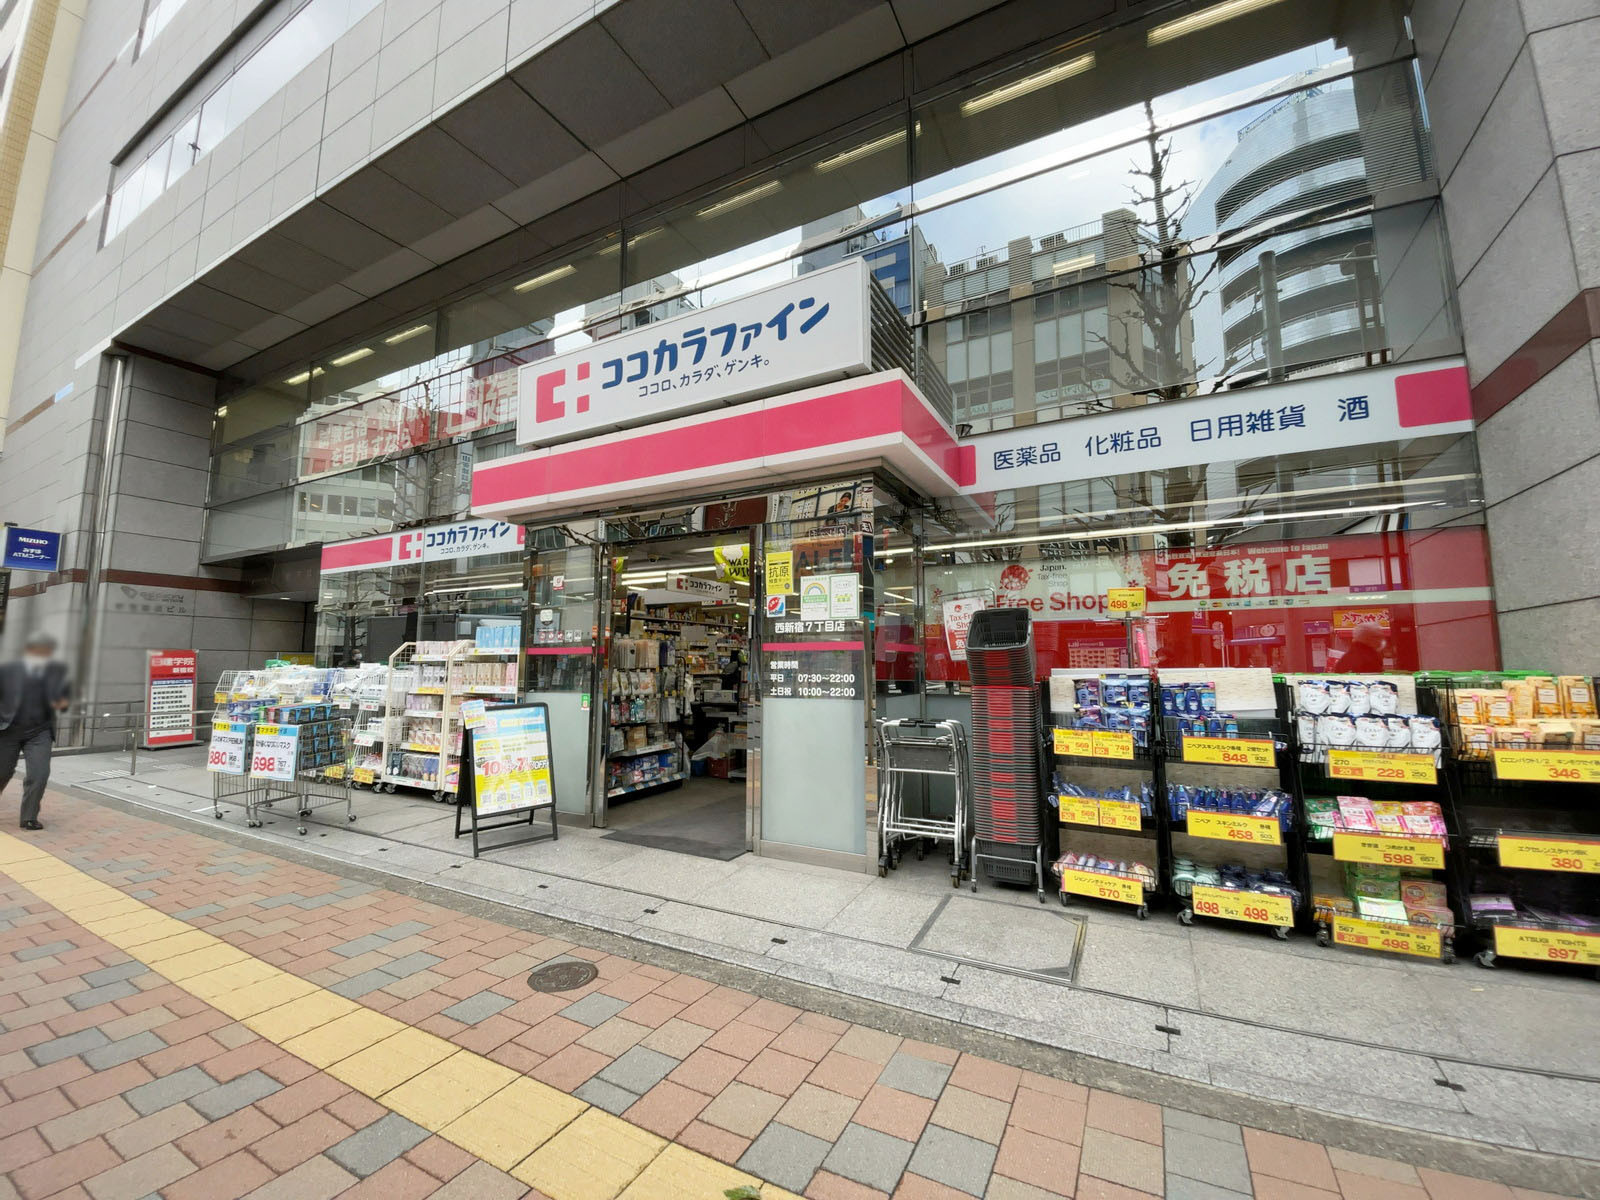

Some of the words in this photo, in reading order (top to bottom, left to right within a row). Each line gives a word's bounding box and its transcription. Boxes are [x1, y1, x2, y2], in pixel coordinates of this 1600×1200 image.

[602, 297, 830, 389] ココカラファイン
[638, 355, 770, 397] ココロ、カラダ、ゲンキ。
[993, 442, 1061, 471] 医薬品
[1085, 427, 1161, 457] 化粧品
[1191, 403, 1306, 443] 日用雑貨
[1338, 395, 1369, 422] 酒
[426, 522, 511, 547] ココカラファイン
[18, 537, 48, 545] MIZUHO
[1247, 545, 1289, 556] Welcome
[728, 558, 750, 567] WAR
[768, 565, 789, 578] 抗原
[1168, 554, 1331, 598] 免税店
[1110, 600, 1128, 609] 498
[770, 660, 798, 670] 営業時間
[770, 674, 784, 683] 平日
[770, 687, 792, 696] 土日祝
[1222, 753, 1248, 763] 848
[254, 757, 275, 772] 698
[1377, 768, 1405, 778] 228
[1548, 768, 1581, 779] 346
[1228, 829, 1253, 840] 458
[1383, 853, 1413, 865] 598
[1552, 857, 1583, 869] 380
[1099, 887, 1121, 899] 570
[1195, 901, 1220, 915] 498
[1243, 906, 1269, 921] 498
[1382, 938, 1410, 950] 498
[1548, 948, 1579, 960] 897
